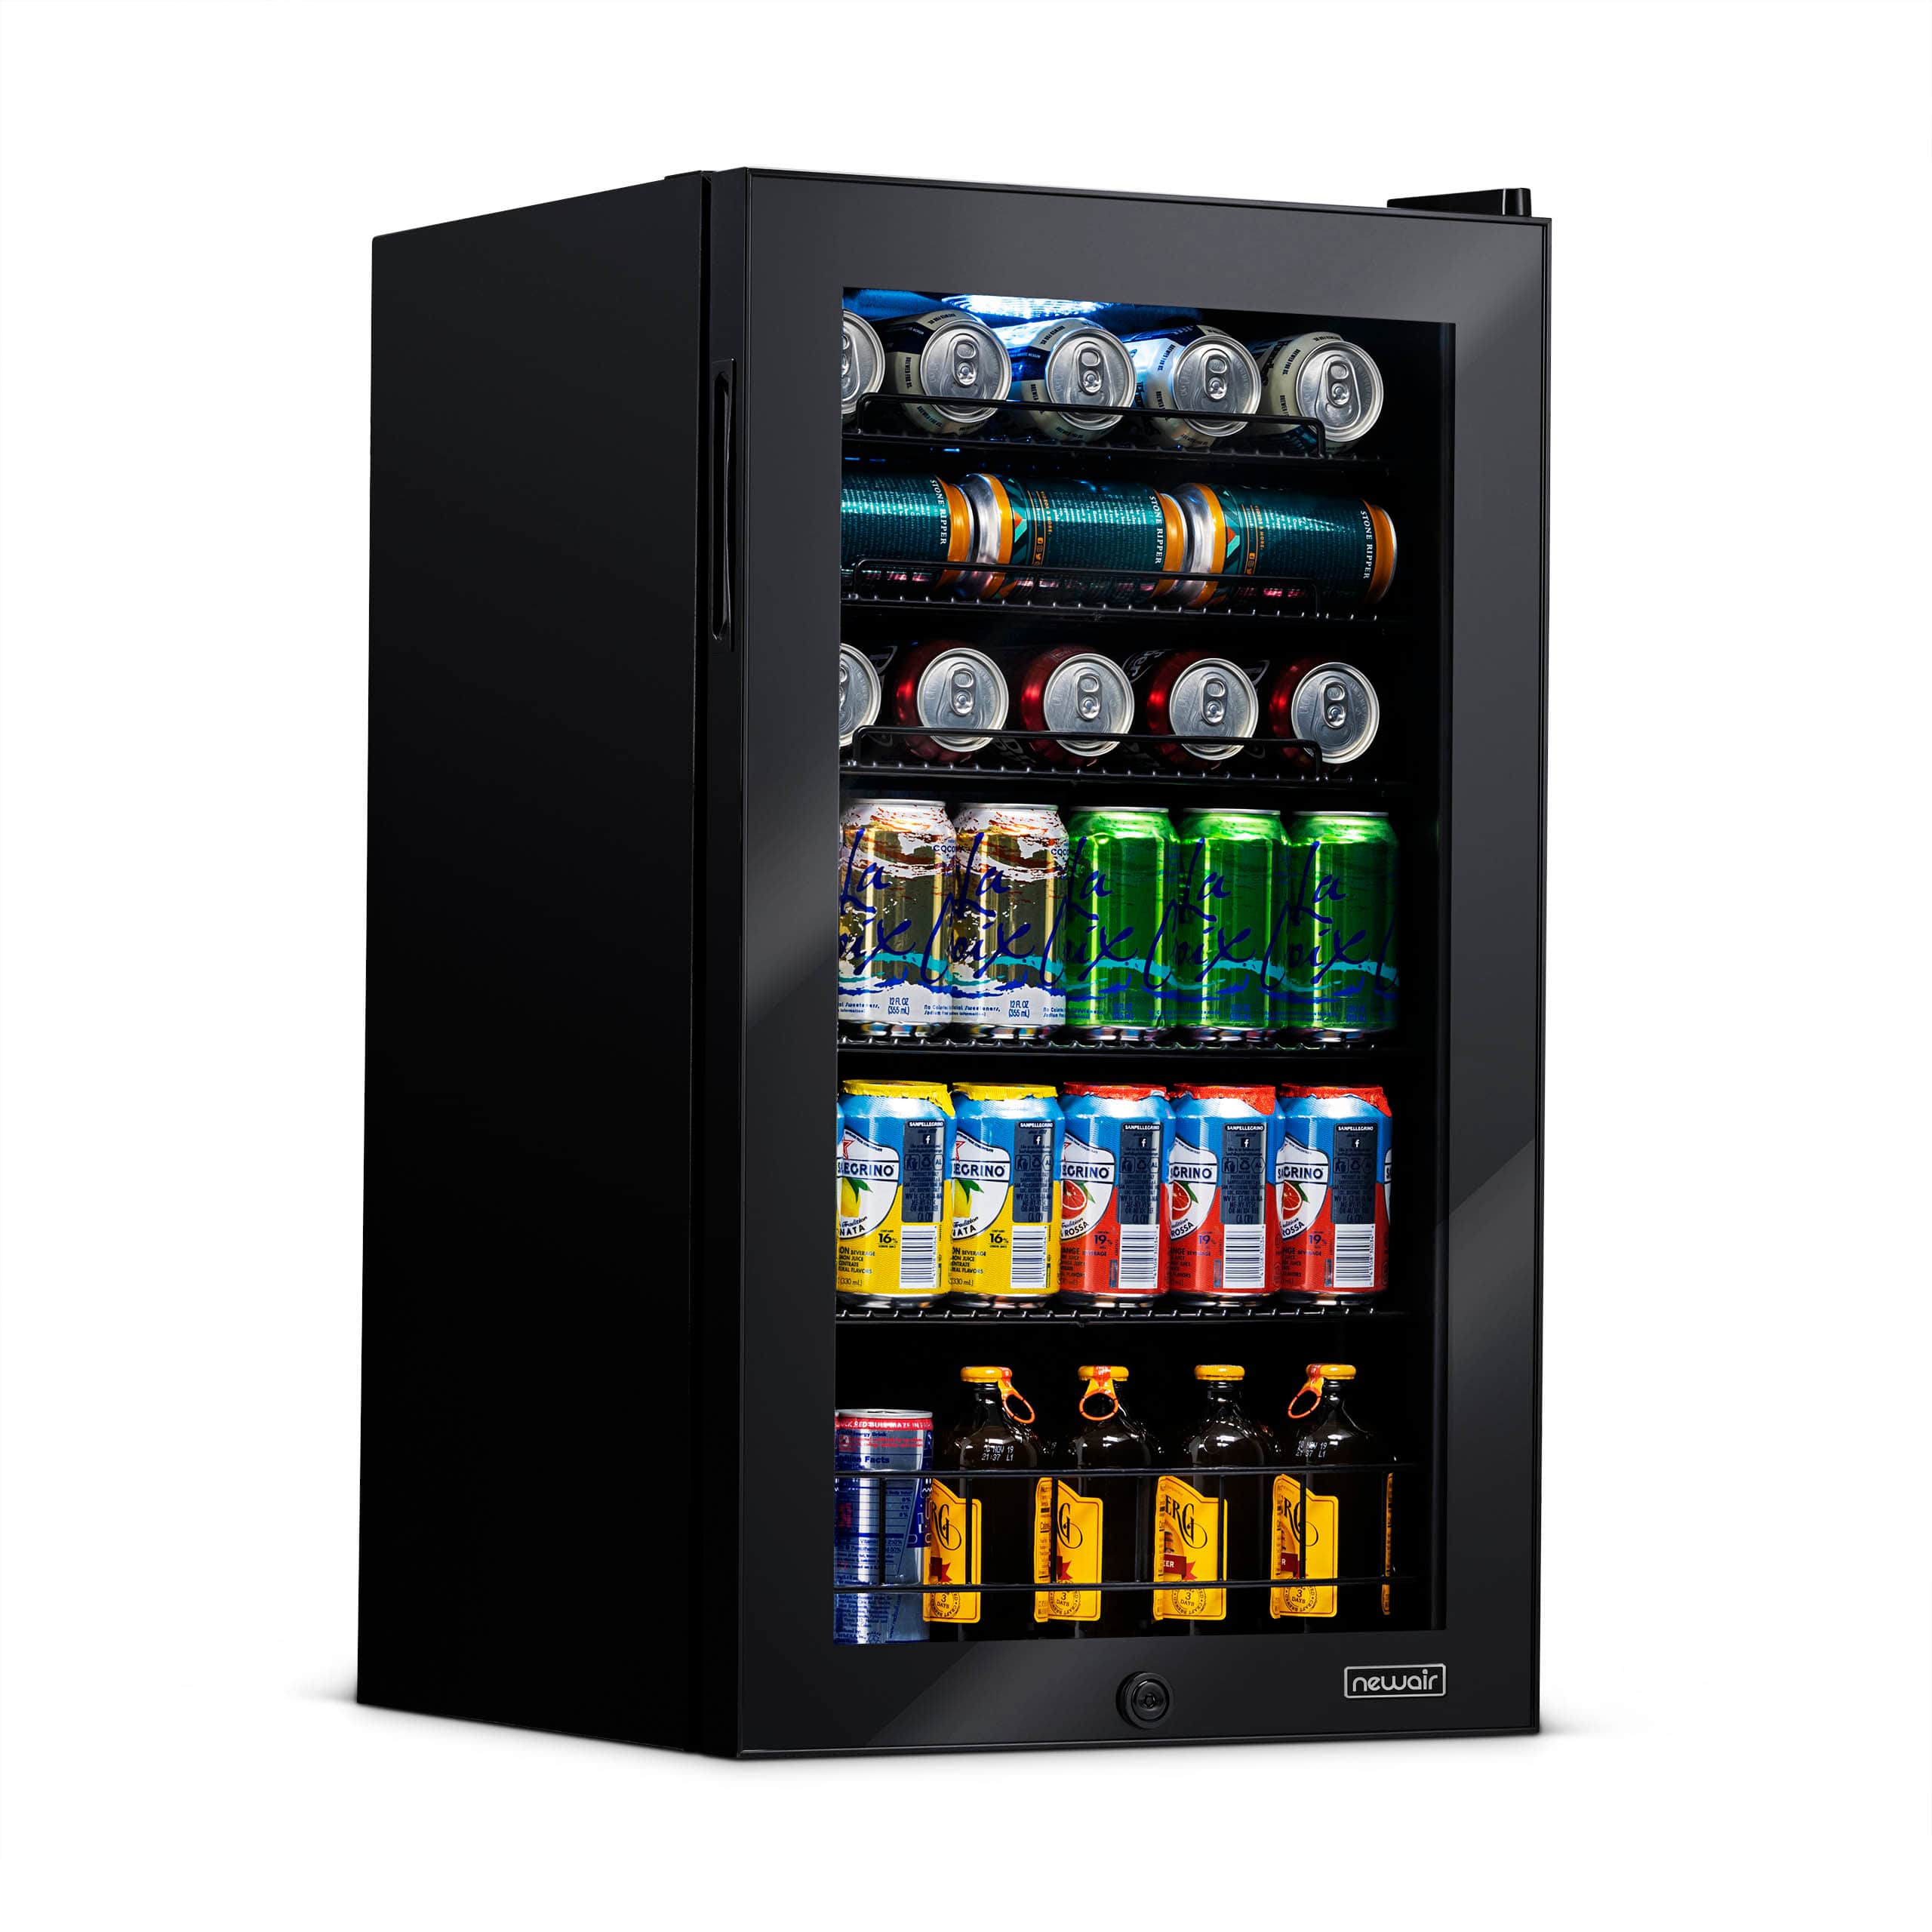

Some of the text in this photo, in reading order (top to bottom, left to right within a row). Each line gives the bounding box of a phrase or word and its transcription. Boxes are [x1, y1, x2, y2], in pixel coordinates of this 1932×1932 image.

[930, 479, 947, 545] STONE RIPPER
[1149, 495, 1164, 565] STONE RIPPER
[1361, 510, 1373, 580] STONE RIPPER
[889, 997, 909, 1005] 12 FL OZ
[1010, 1000, 1029, 1008] 12 FL OZ
[888, 1006, 900, 1015] (355
[1008, 1009, 1020, 1018] (355
[1064, 1222, 1088, 1236] ROSSA
[1171, 1222, 1194, 1238] ROSSA
[1008, 1445, 1015, 1454] 19
[1320, 1441, 1328, 1450] 19
[1351, 1669, 1438, 1693] newair
